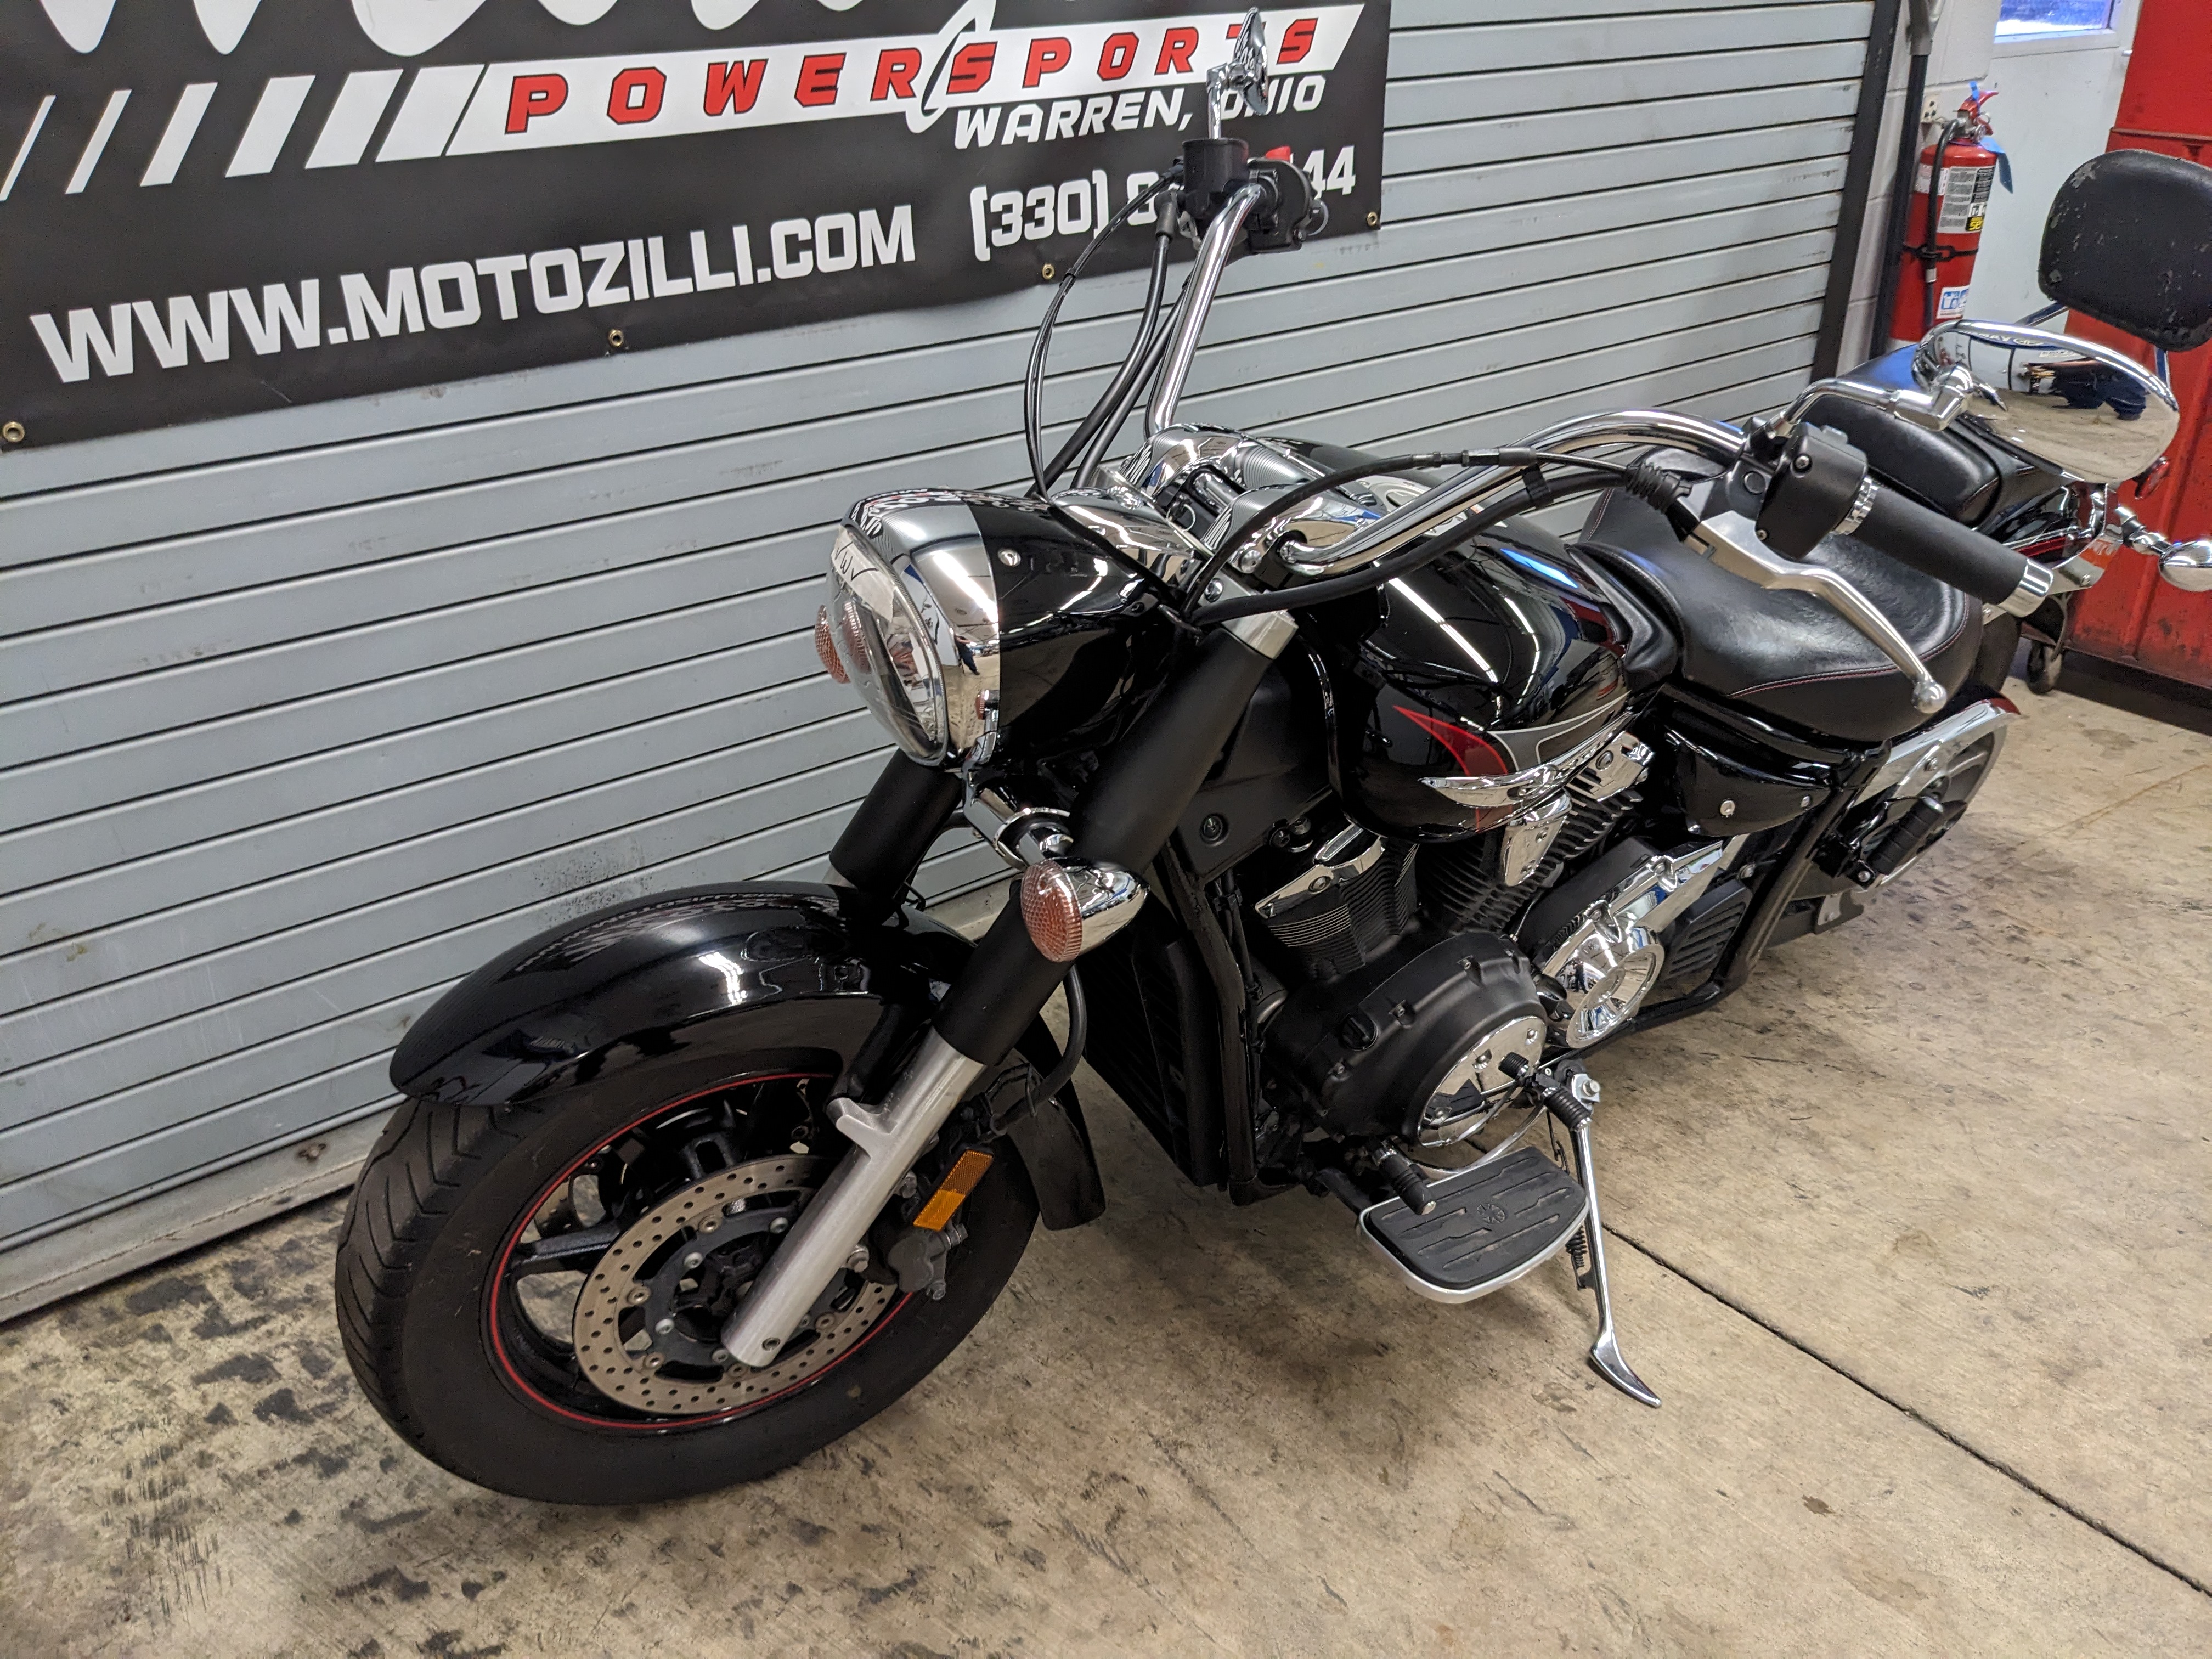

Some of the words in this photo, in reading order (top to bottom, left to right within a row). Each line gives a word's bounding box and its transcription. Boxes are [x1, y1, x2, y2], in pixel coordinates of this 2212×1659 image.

[955, 88, 1193, 150] WARREN,
[970, 169, 1109, 262] (330)
[30, 204, 916, 383] WWW.MOTOZILLI.COM
